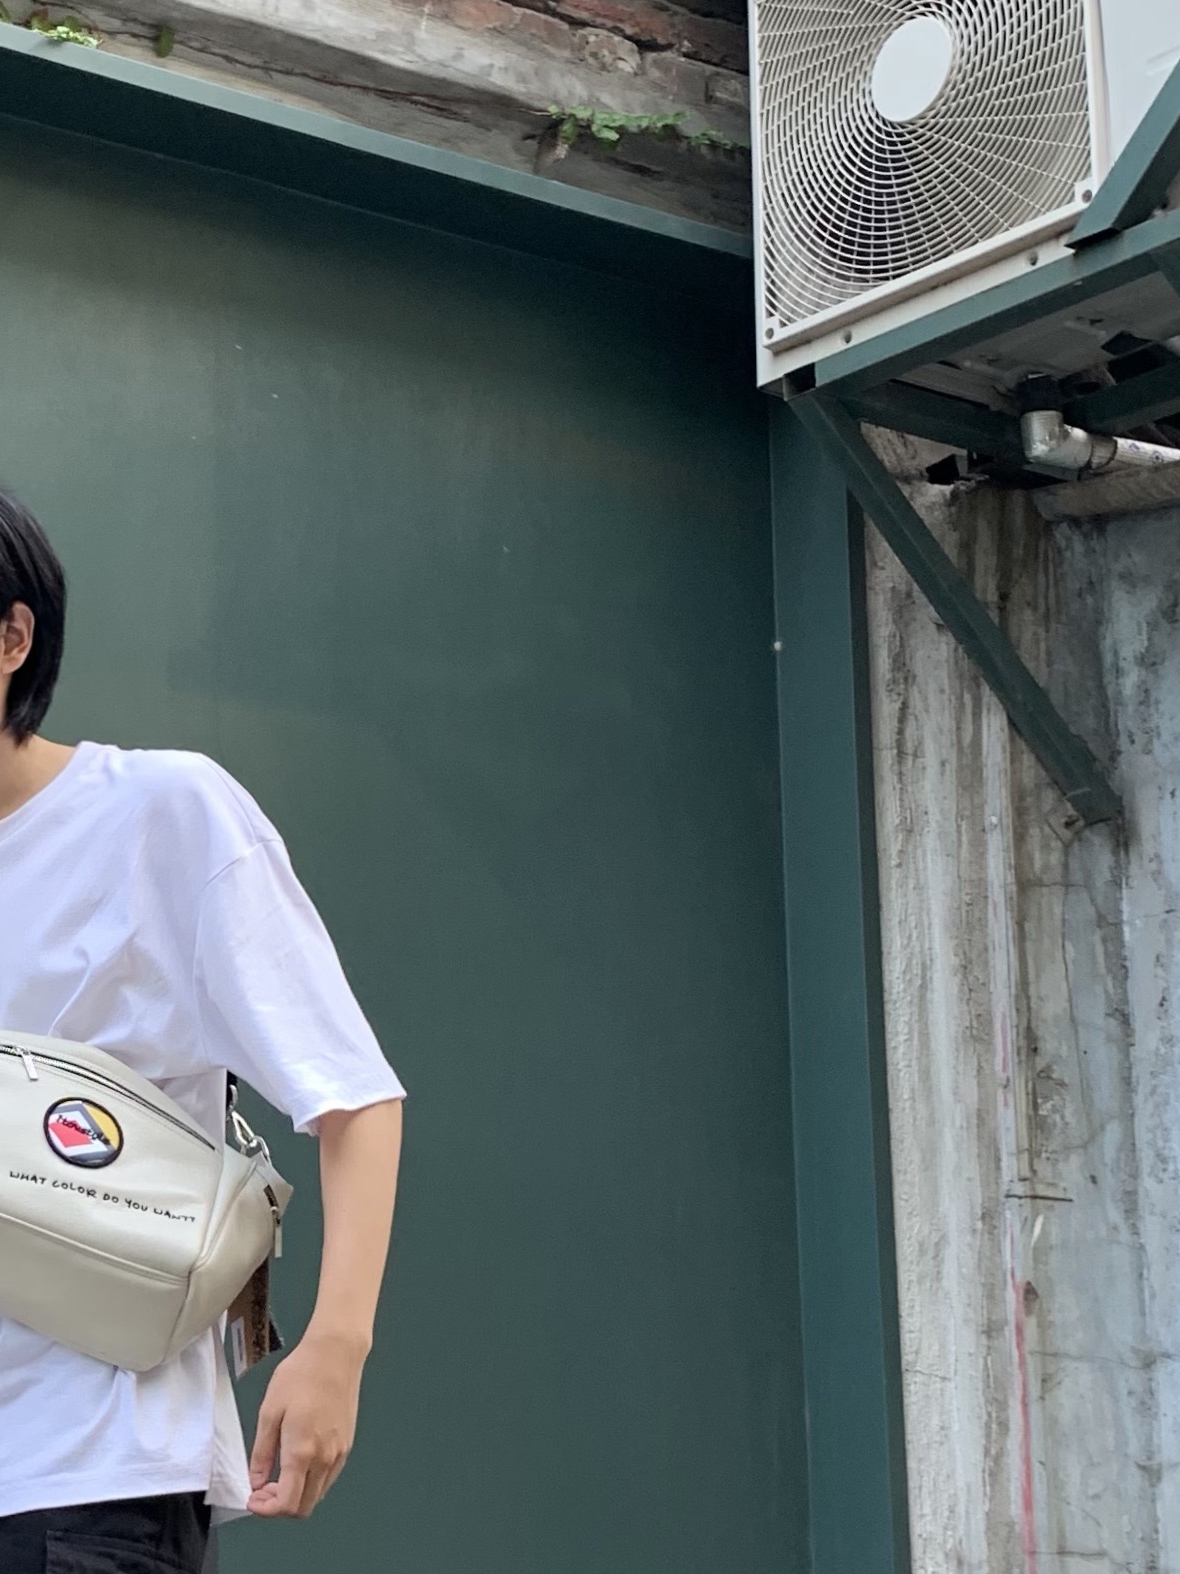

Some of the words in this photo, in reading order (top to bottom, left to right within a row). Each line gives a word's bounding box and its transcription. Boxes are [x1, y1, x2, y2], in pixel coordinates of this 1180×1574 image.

[9, 1170, 47, 1185] WHAT
[52, 1180, 97, 1199] COLOR
[103, 1192, 119, 1204] DO
[124, 1198, 149, 1212] YOU
